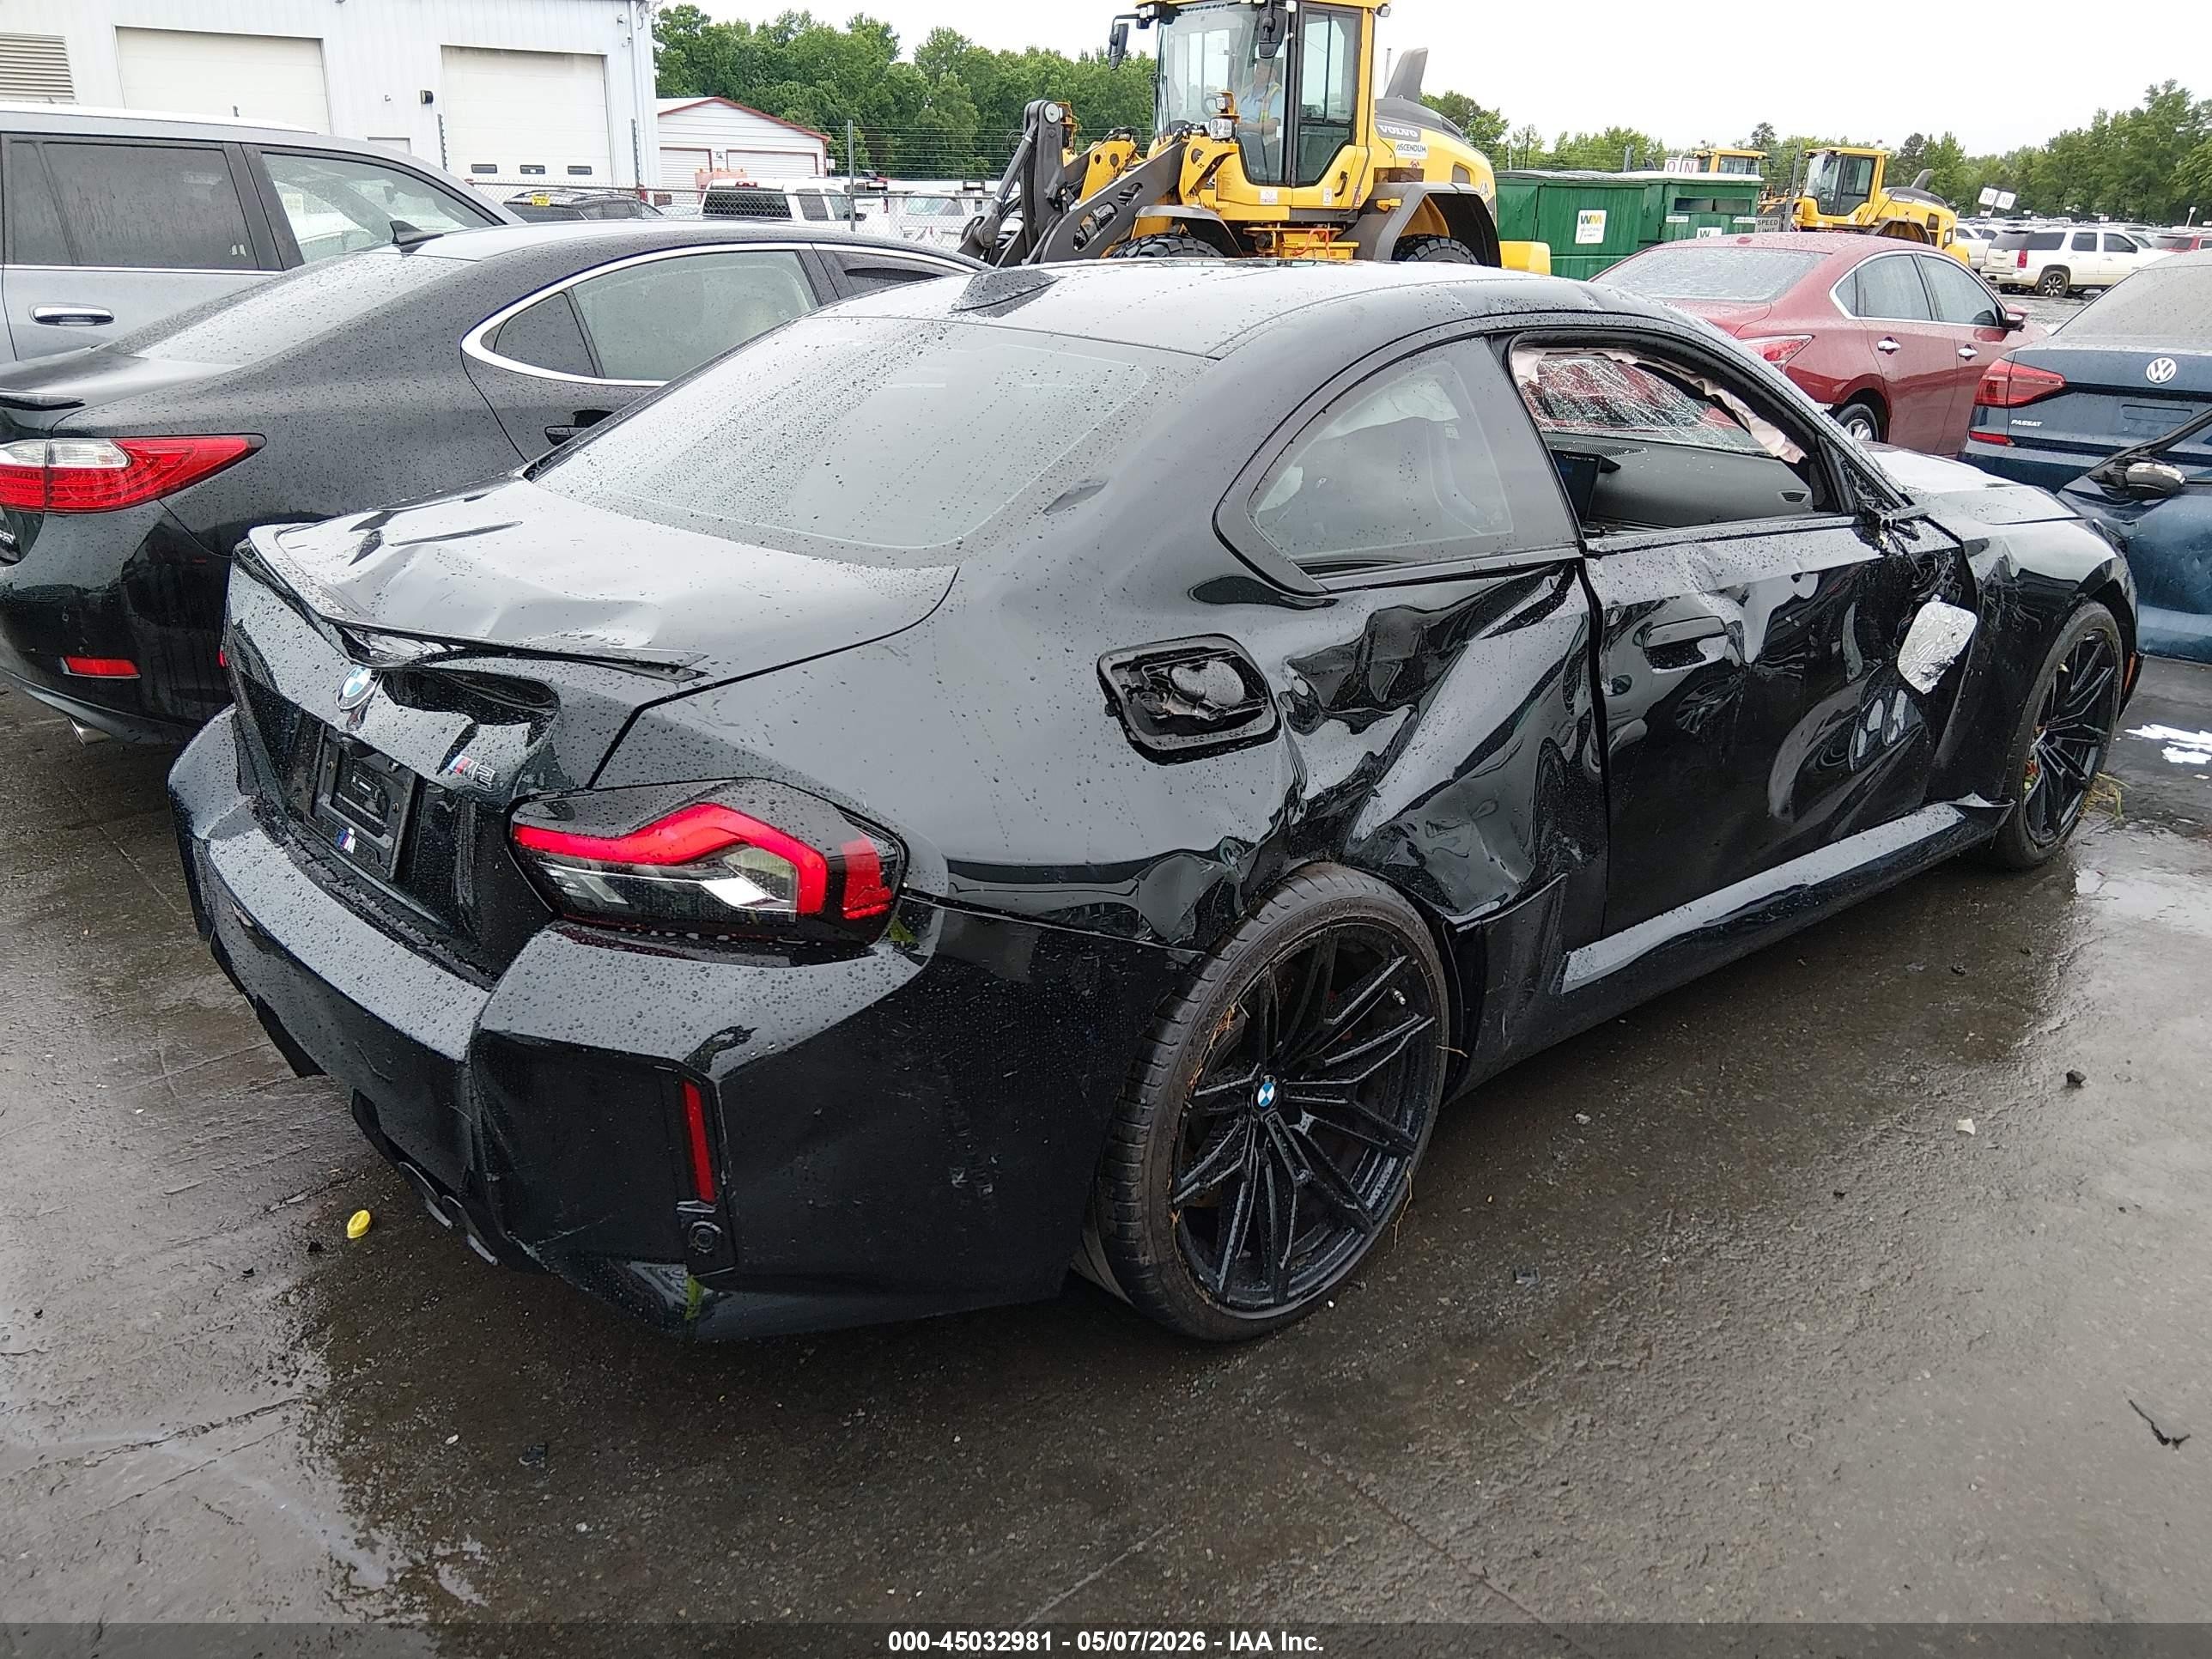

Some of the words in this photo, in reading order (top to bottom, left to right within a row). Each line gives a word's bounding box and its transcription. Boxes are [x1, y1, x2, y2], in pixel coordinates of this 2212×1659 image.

[1376, 125, 1419, 137] VOLVO
[1984, 192, 1994, 201] 10
[2001, 197, 2012, 205] 10
[1580, 215, 1602, 225] WM
